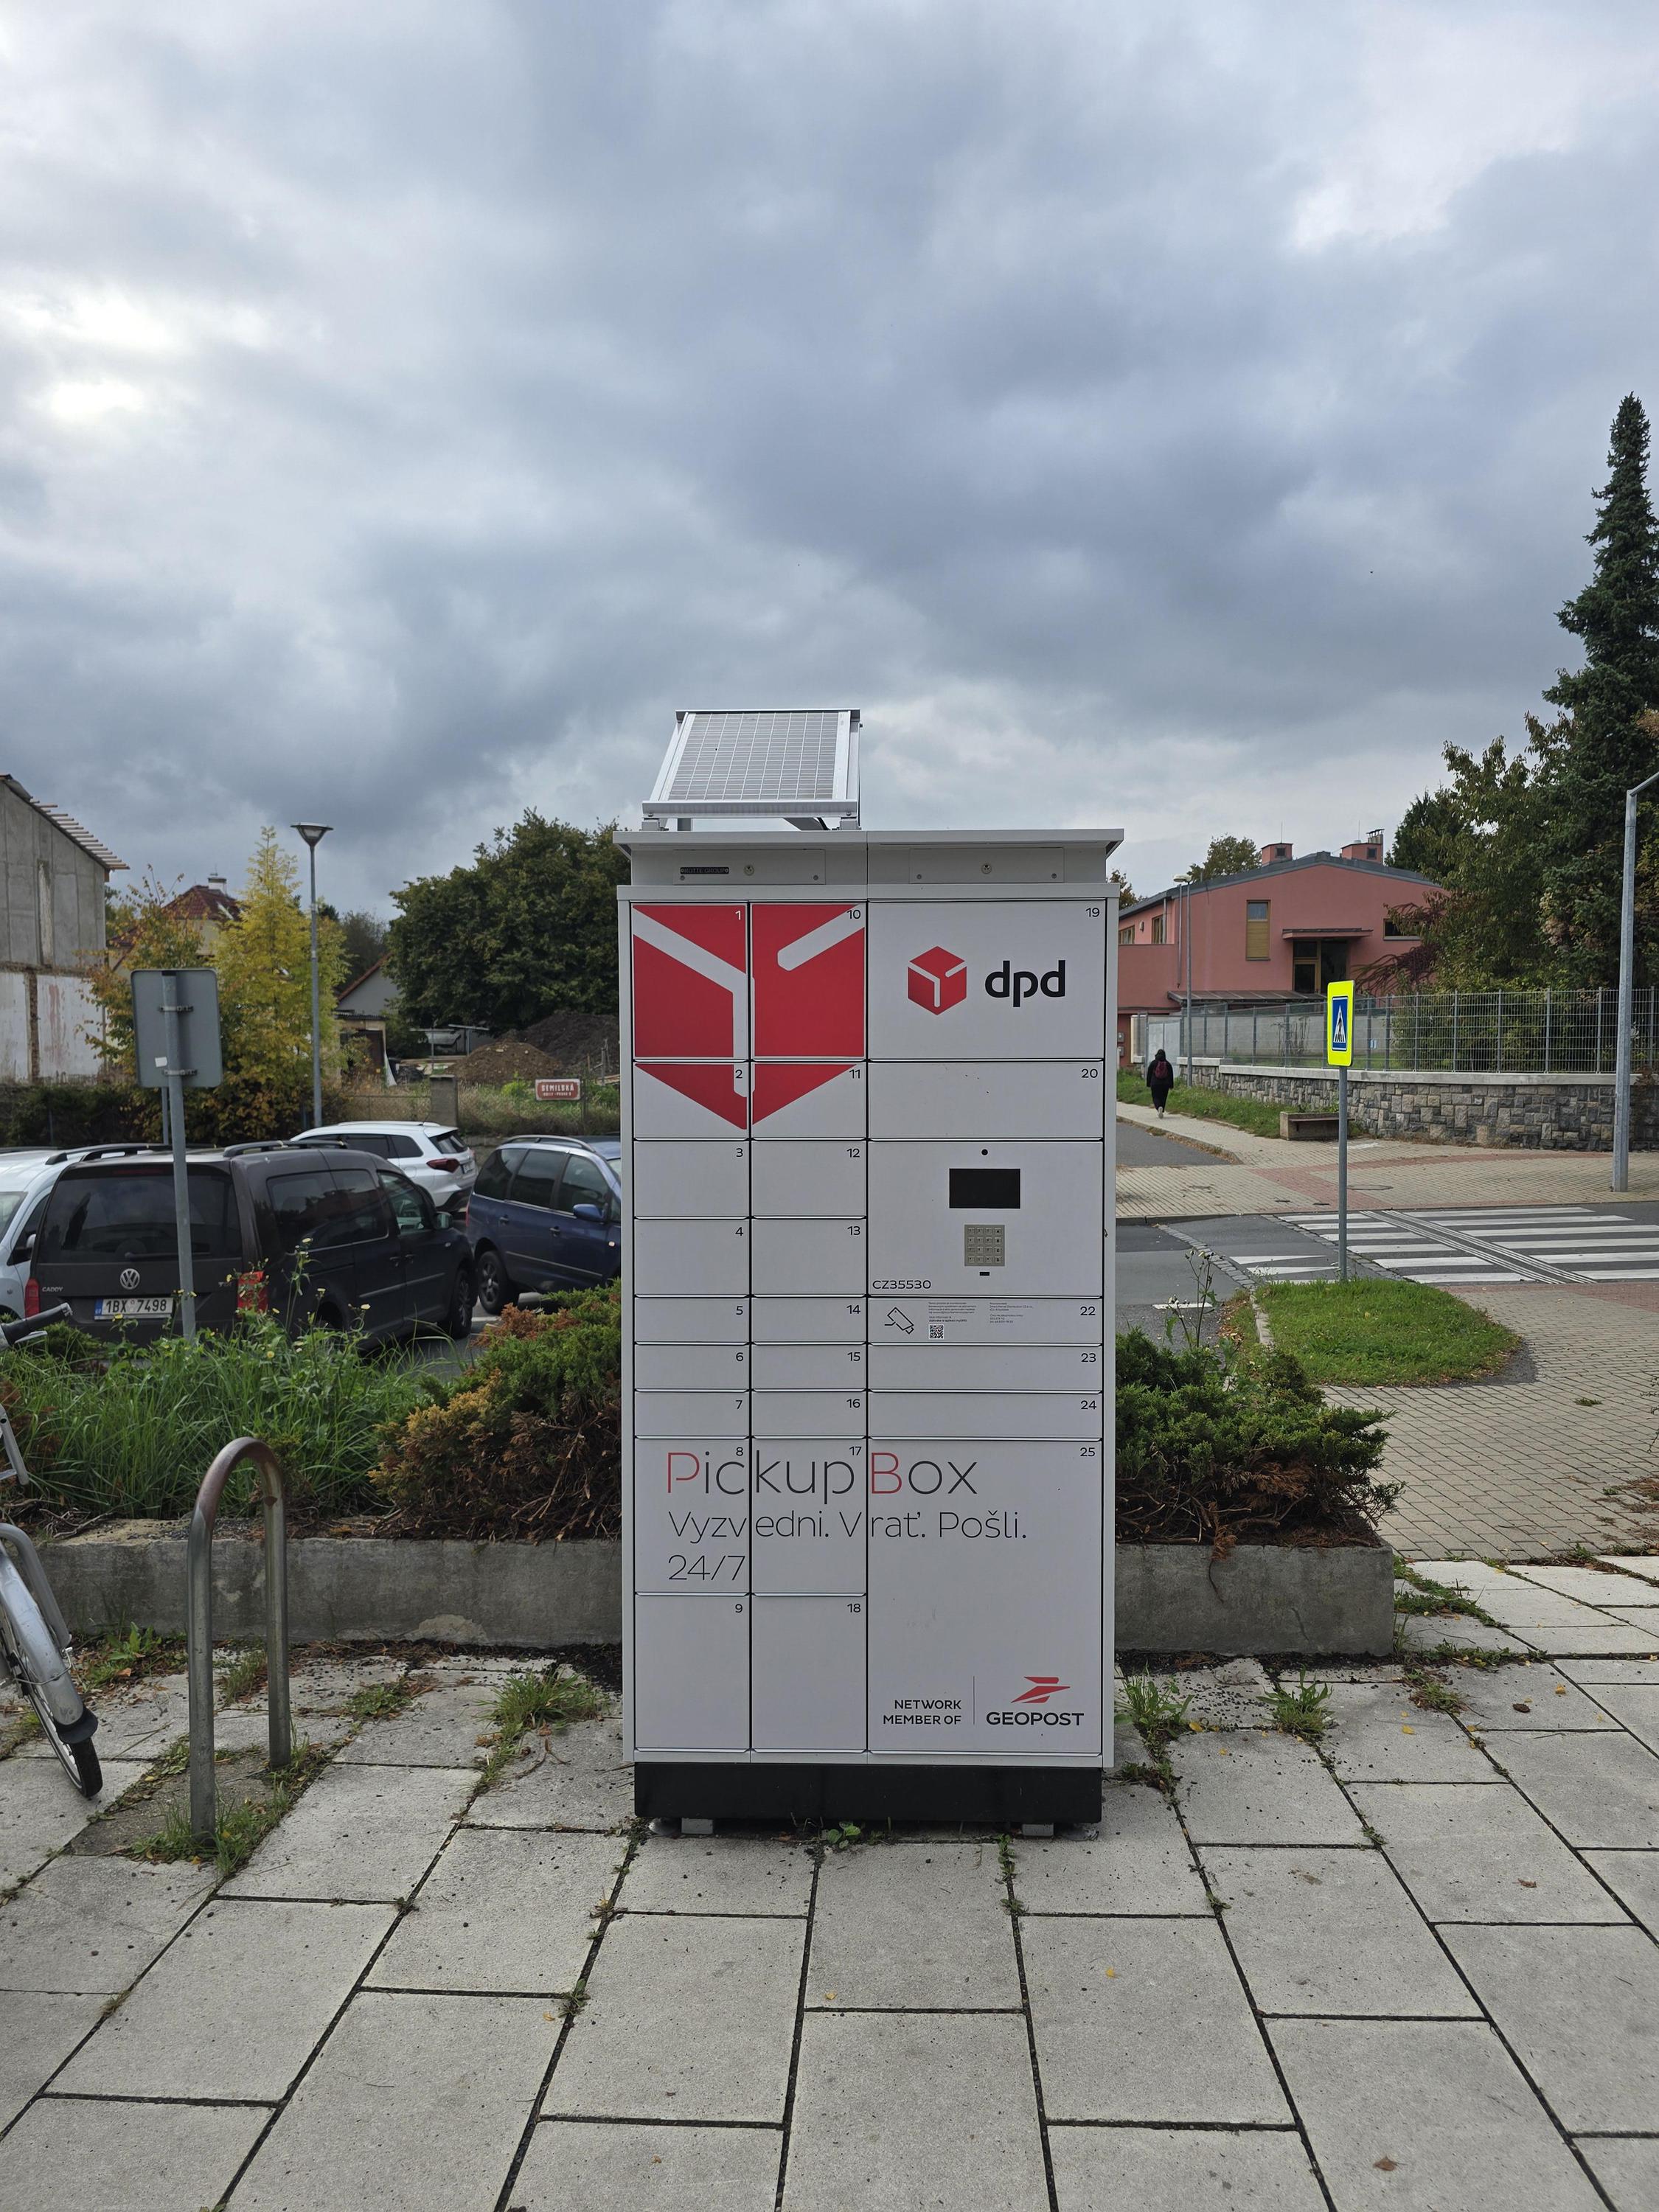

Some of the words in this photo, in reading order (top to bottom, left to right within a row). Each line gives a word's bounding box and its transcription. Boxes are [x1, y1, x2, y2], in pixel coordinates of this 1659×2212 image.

[735, 911, 740, 919] 1
[847, 909, 860, 919] 10
[1086, 908, 1099, 917] 19
[985, 960, 1065, 1007] dpd
[735, 1069, 742, 1079] 2
[849, 1069, 860, 1079] 11
[1082, 1069, 1098, 1079] 20
[737, 1148, 742, 1157] 3
[847, 1149, 860, 1158] 12
[735, 1227, 743, 1236] 4
[848, 1226, 860, 1235] 13
[873, 1280, 931, 1290] CZ35530
[106, 1300, 128, 1313] 1BX
[136, 1299, 167, 1312] 7498
[736, 1306, 742, 1315] 5
[846, 1305, 860, 1314] 14
[1080, 1307, 1095, 1315] 22
[736, 1352, 743, 1361] 6
[848, 1352, 860, 1361] 15
[1082, 1353, 1096, 1362] 23
[736, 1400, 742, 1409] 7
[846, 1399, 860, 1408] 16
[1081, 1400, 1096, 1409] 24
[736, 1447, 743, 1456] 8
[849, 1447, 861, 1455] 17
[1080, 1447, 1095, 1456] 25
[668, 1510, 830, 1544] Vyzvedni.
[839, 1510, 926, 1539] Vrať.
[940, 1510, 1026, 1538] Pošli.
[668, 1554, 745, 1581] 24/7
[735, 1604, 742, 1613] 9
[847, 1604, 860, 1613] 18
[895, 1700, 961, 1709] NETWORK
[883, 1715, 941, 1725] MEMBER
[944, 1716, 961, 1725] OF
[987, 1712, 1084, 1725] GEOPOST
